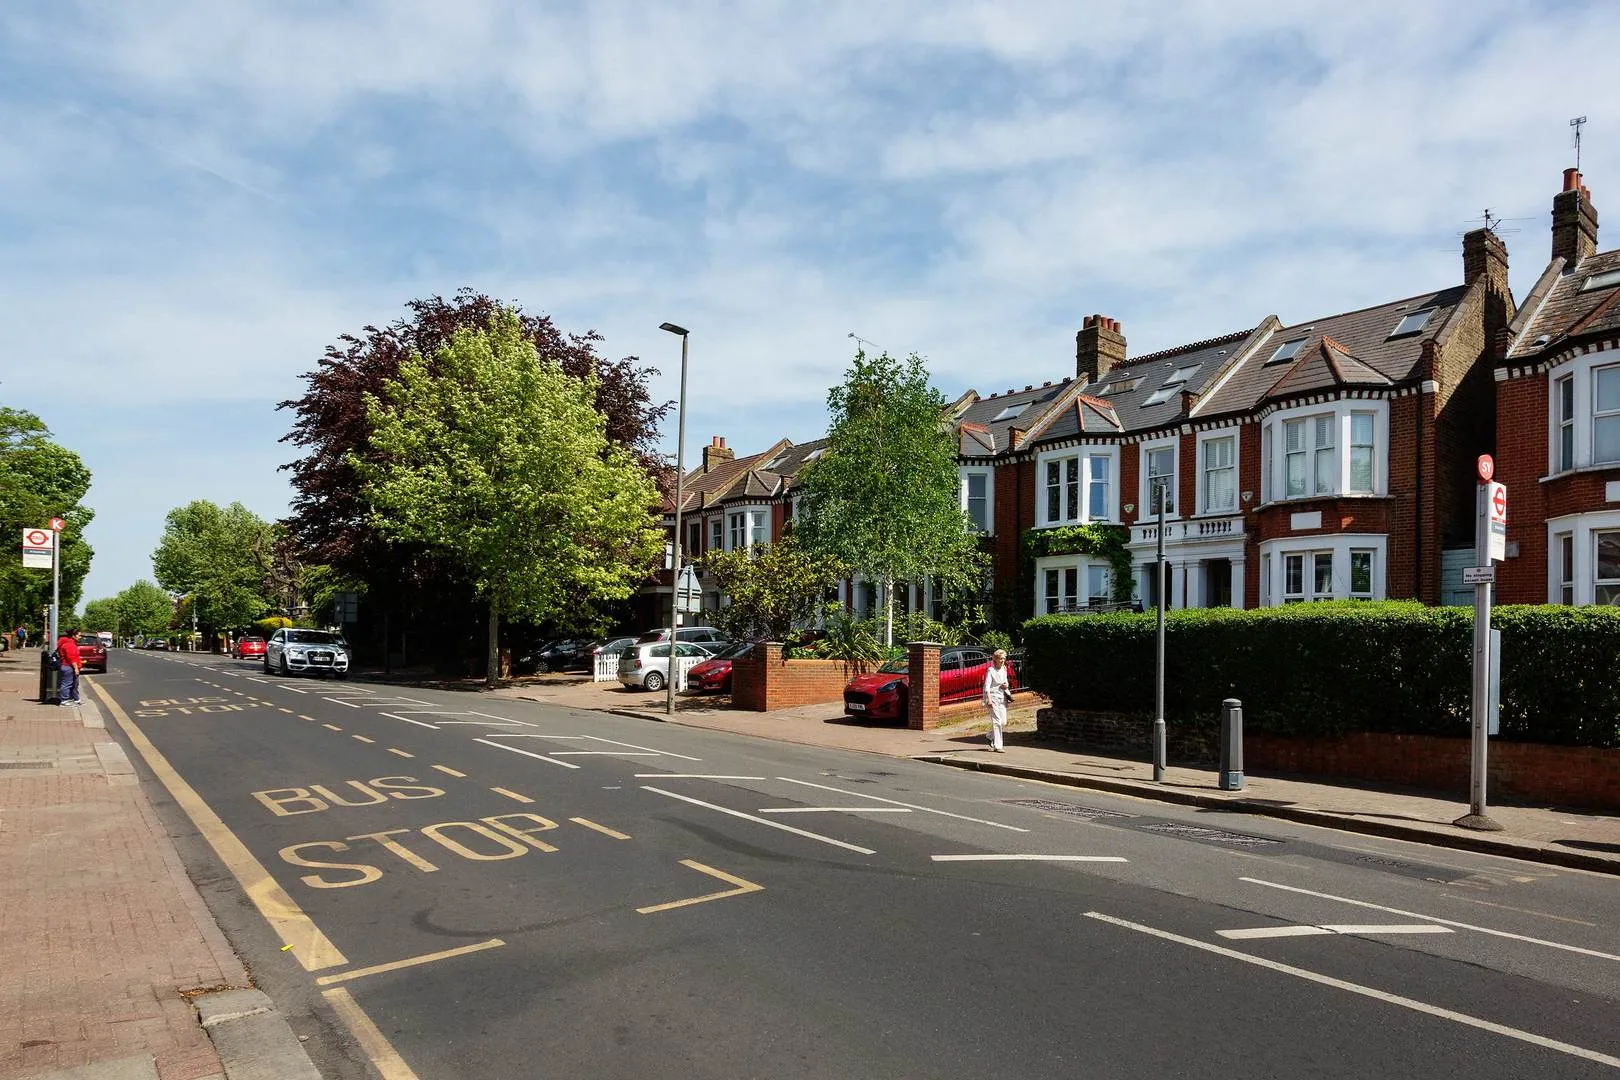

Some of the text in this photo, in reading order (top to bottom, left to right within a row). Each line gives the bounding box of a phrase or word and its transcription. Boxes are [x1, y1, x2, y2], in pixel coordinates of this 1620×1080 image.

[1481, 461, 1492, 473] SY
[52, 519, 62, 530] K
[139, 696, 229, 707] BUS
[134, 703, 259, 717] STOP
[251, 776, 446, 816] BUS
[278, 813, 559, 889] STOP
